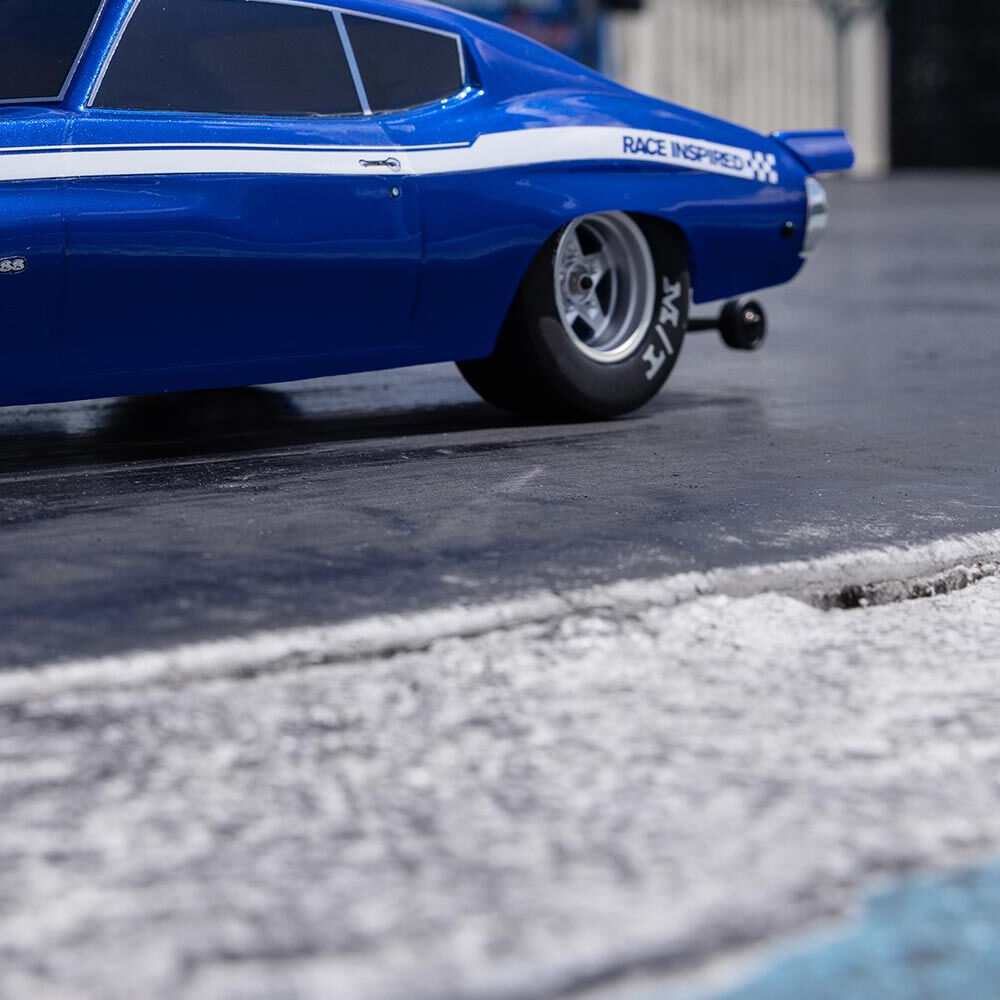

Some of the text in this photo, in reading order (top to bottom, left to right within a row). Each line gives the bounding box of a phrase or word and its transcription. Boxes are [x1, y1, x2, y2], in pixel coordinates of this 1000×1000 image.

[622, 136, 744, 171] RACE INSPIRED
[0, 258, 25, 272] SS
